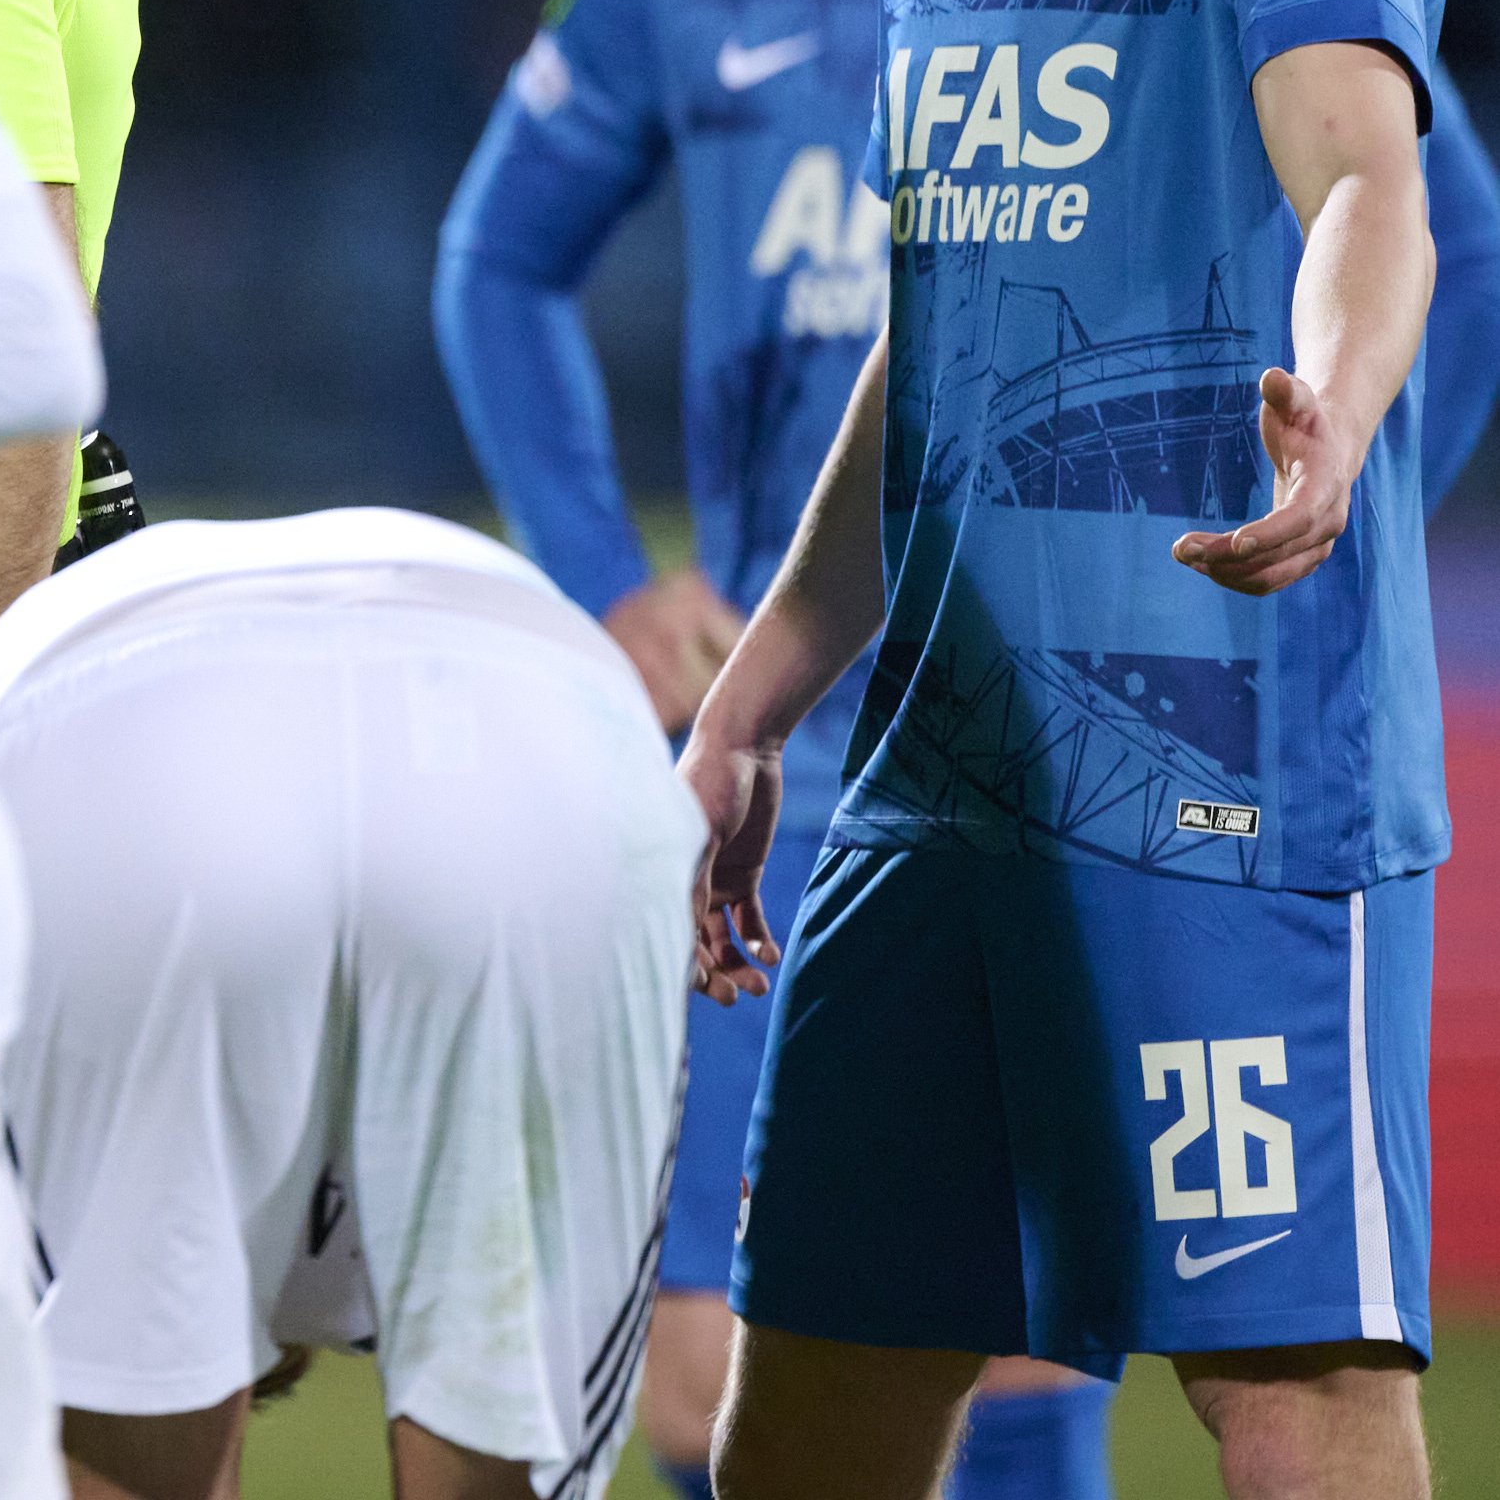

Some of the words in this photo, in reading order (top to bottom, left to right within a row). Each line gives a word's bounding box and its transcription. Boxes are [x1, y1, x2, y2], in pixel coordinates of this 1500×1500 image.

[891, 169, 1089, 244] oftware
[1214, 817, 1225, 830] IS
[1224, 817, 1251, 832] OURS
[1139, 1036, 1298, 1222] 26
